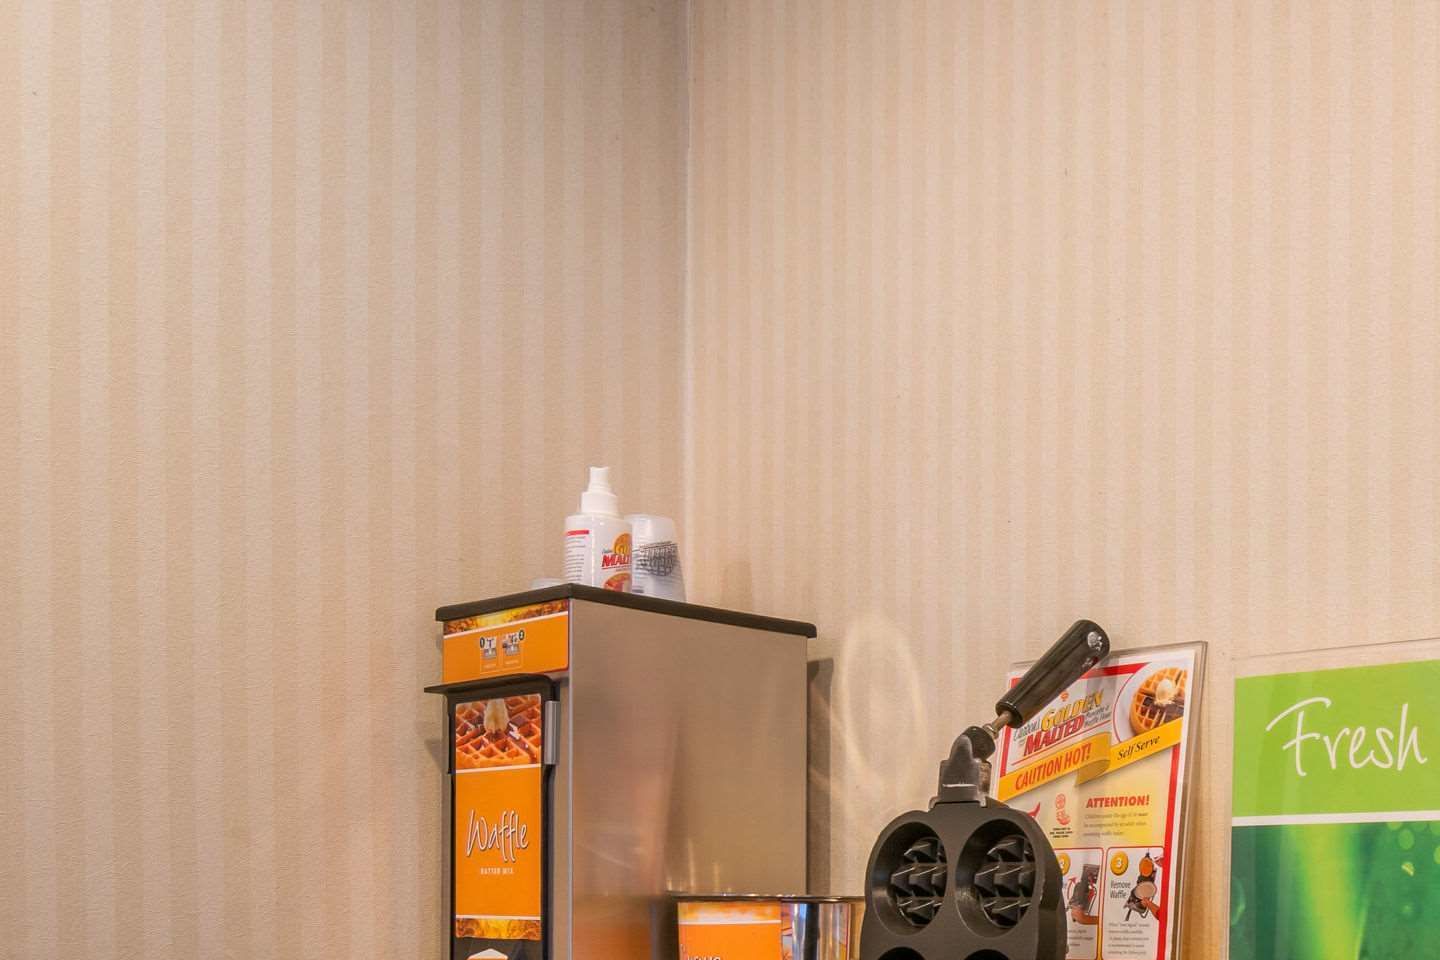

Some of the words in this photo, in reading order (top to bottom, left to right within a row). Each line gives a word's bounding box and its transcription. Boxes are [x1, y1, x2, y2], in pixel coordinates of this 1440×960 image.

[1023, 714, 1086, 757] MALTED
[1116, 743, 1134, 761] Self
[1136, 734, 1160, 751] Serve
[1266, 697, 1428, 777] Fresh
[1015, 753, 1063, 791] CAUTION
[1063, 742, 1093, 771] HOT!
[1086, 795, 1151, 809] ATTENTION!
[466, 809, 529, 863] Waffle
